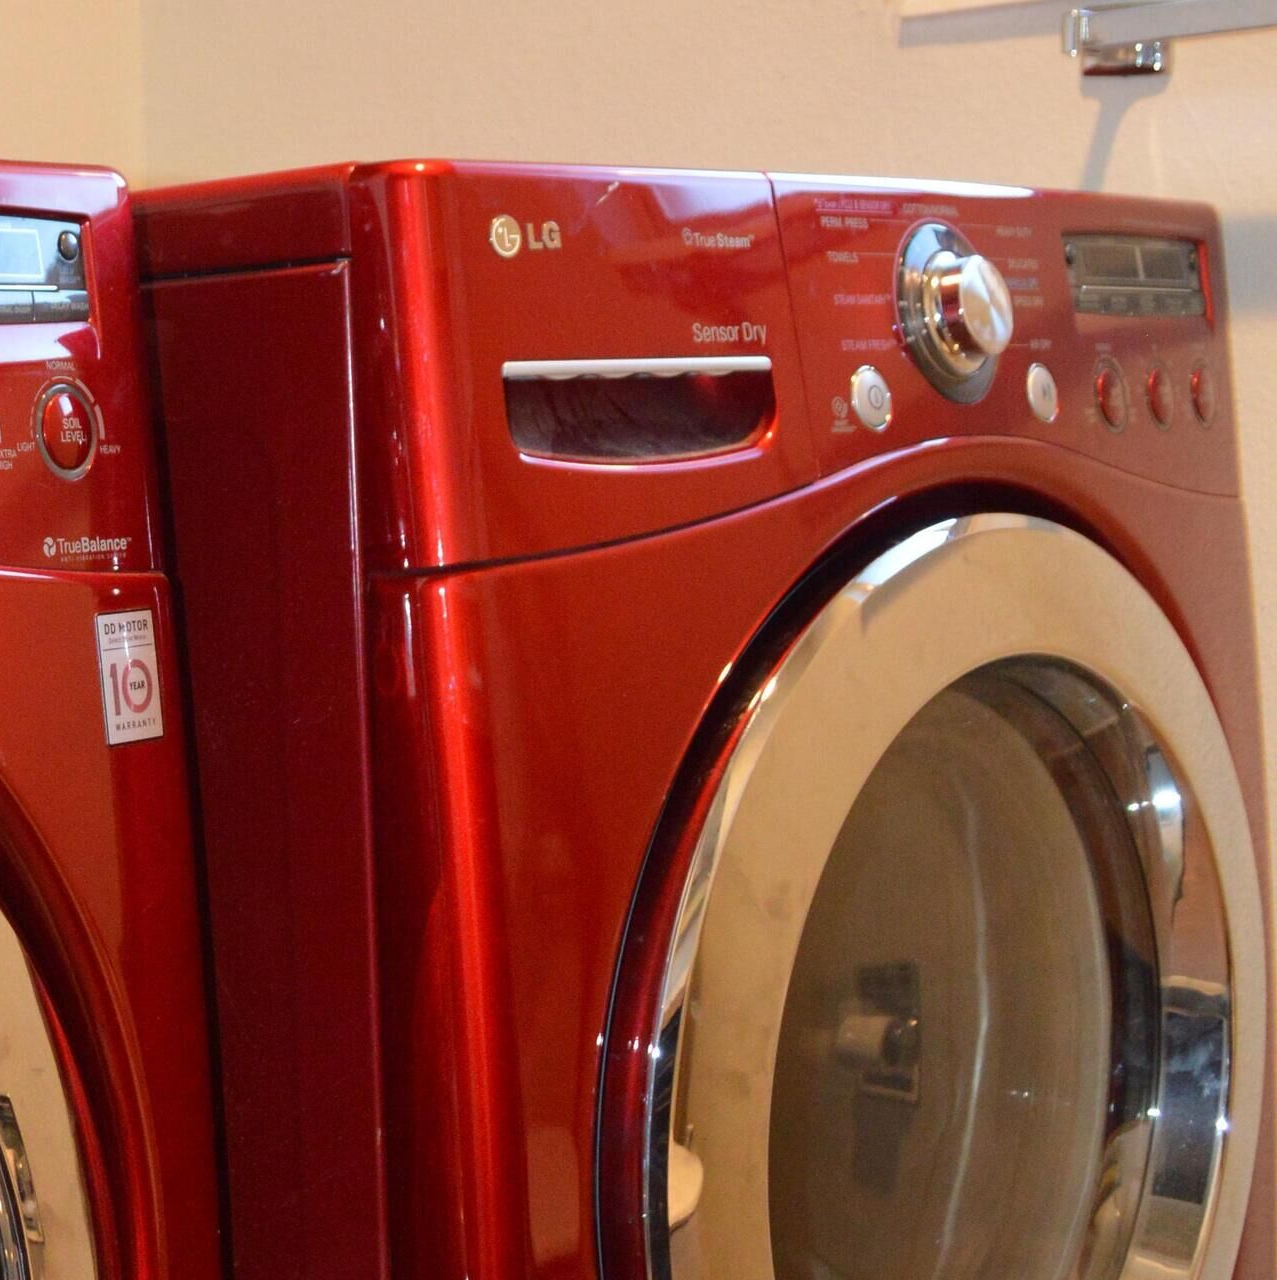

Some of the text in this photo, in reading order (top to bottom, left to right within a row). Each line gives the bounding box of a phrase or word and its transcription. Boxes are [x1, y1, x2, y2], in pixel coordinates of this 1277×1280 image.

[526, 220, 561, 250] LG
[692, 322, 767, 345] Sensor Dry
[45, 360, 75, 371] NORMAL
[62, 417, 83, 429] SOIL
[61, 430, 86, 442] LEVEL
[16, 441, 36, 452] LIGHT
[99, 445, 122, 455] HEAVY
[104, 619, 149, 635] DD MOTOR
[110, 658, 153, 716] 10
[129, 680, 146, 690] YEAR
[115, 718, 157, 731] WARRANTY
